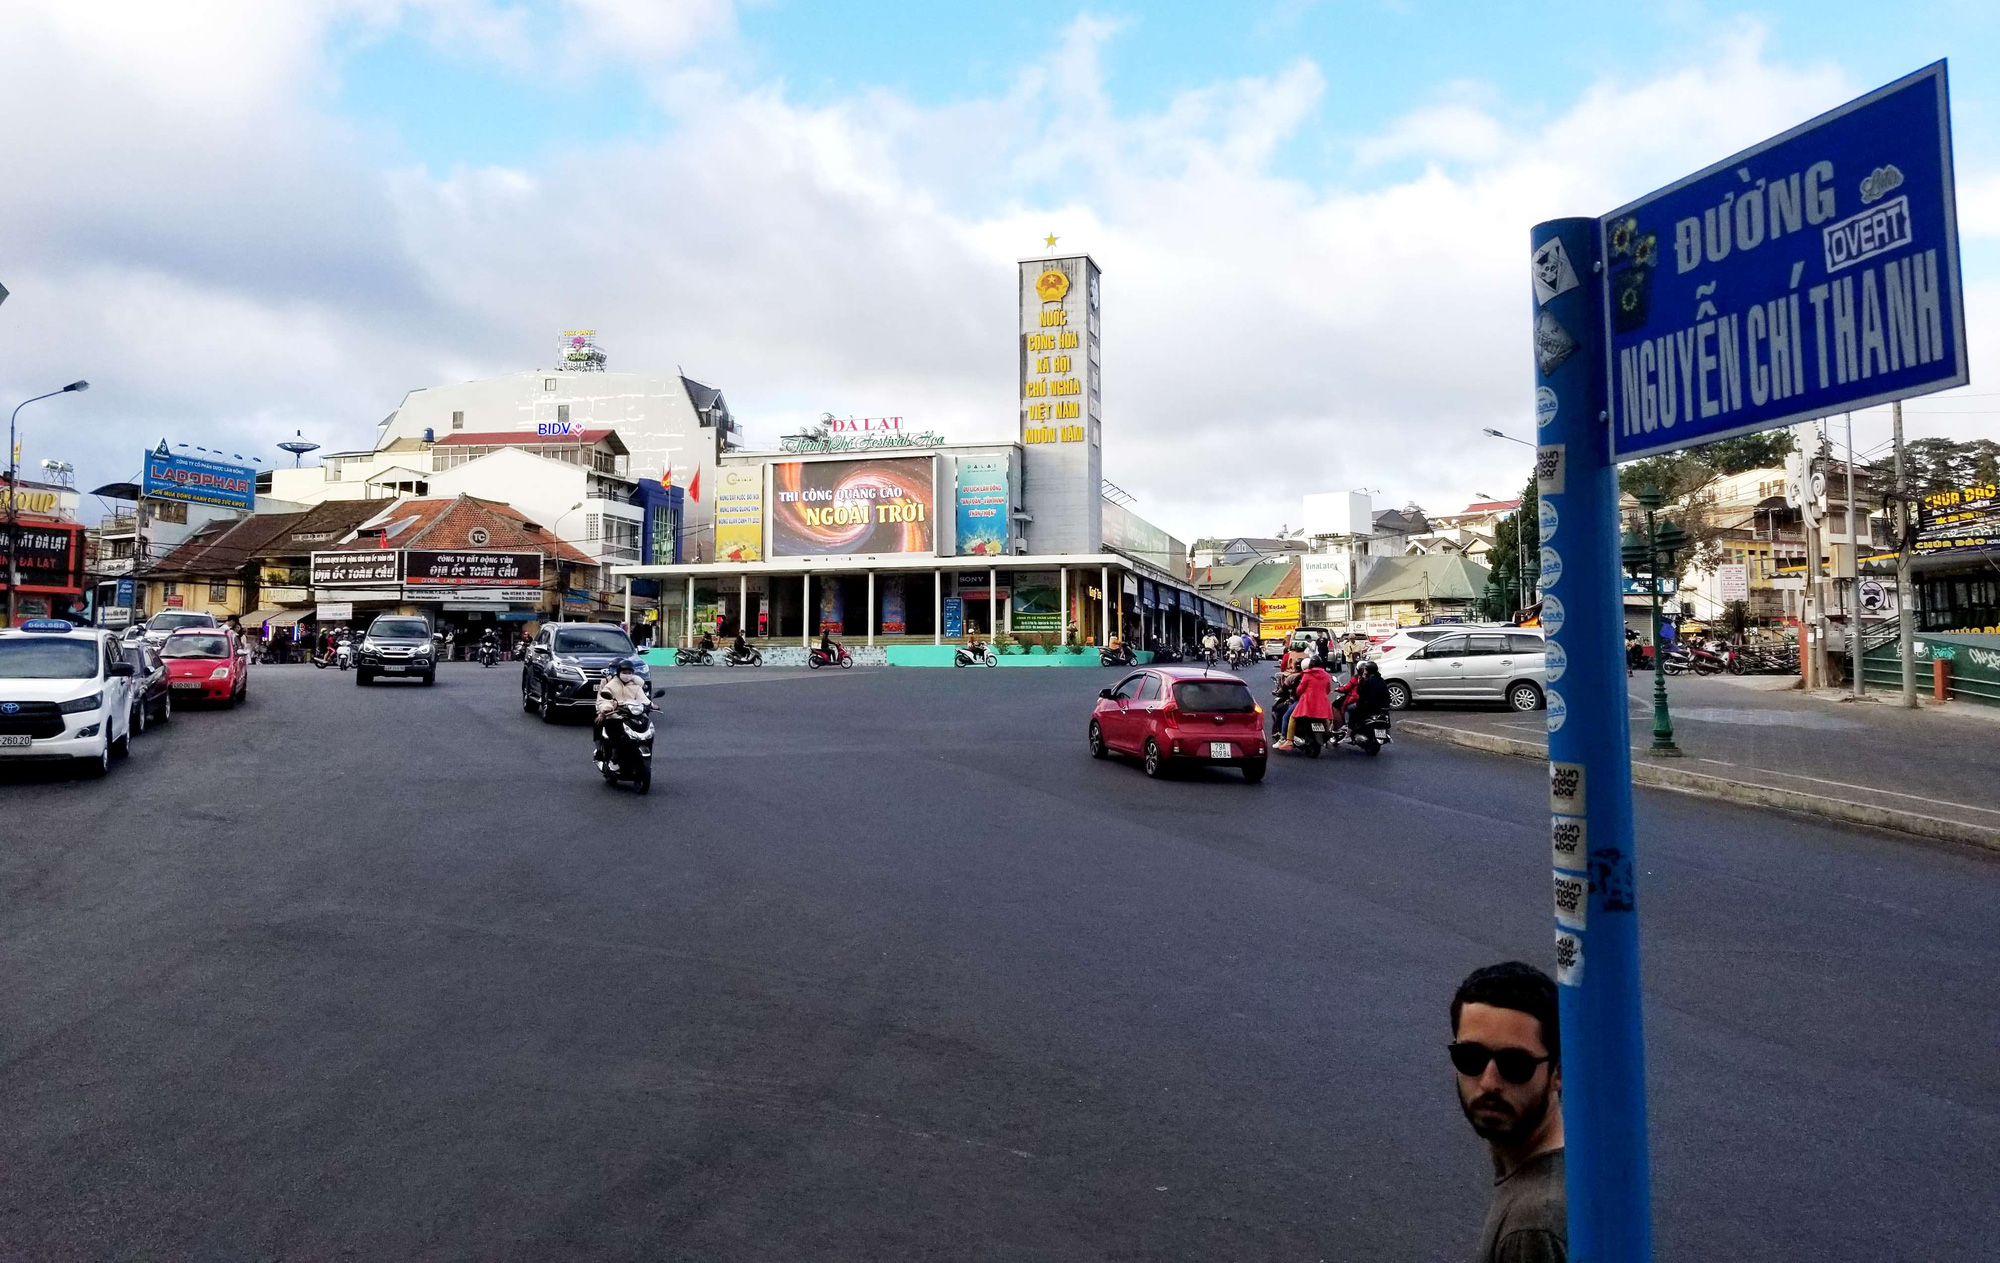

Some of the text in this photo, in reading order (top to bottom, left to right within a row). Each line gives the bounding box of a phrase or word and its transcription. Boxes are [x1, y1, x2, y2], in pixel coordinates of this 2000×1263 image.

[1674, 160, 1836, 275] ĐƯỜNG
[1831, 204, 1902, 263] OVERT
[1620, 248, 1944, 438] NGUYỄN CHÍ THANH
[1028, 402, 1080, 423] VIỆT NAM
[538, 422, 571, 436] BIDV
[832, 414, 903, 433] ĐÀ LẠT
[151, 464, 248, 492] LADOPHAR
[778, 484, 903, 502] THI CÔNG QUẢNG CÁO
[806, 499, 925, 526] NGOÀI TRỜI
[474, 533, 486, 541] TC
[437, 554, 454, 563] CÔNG
[348, 566, 373, 579] TOÀN
[451, 563, 465, 576] ỐC
[469, 565, 495, 577] TOÀN
[1215, 743, 1226, 751] 79A
